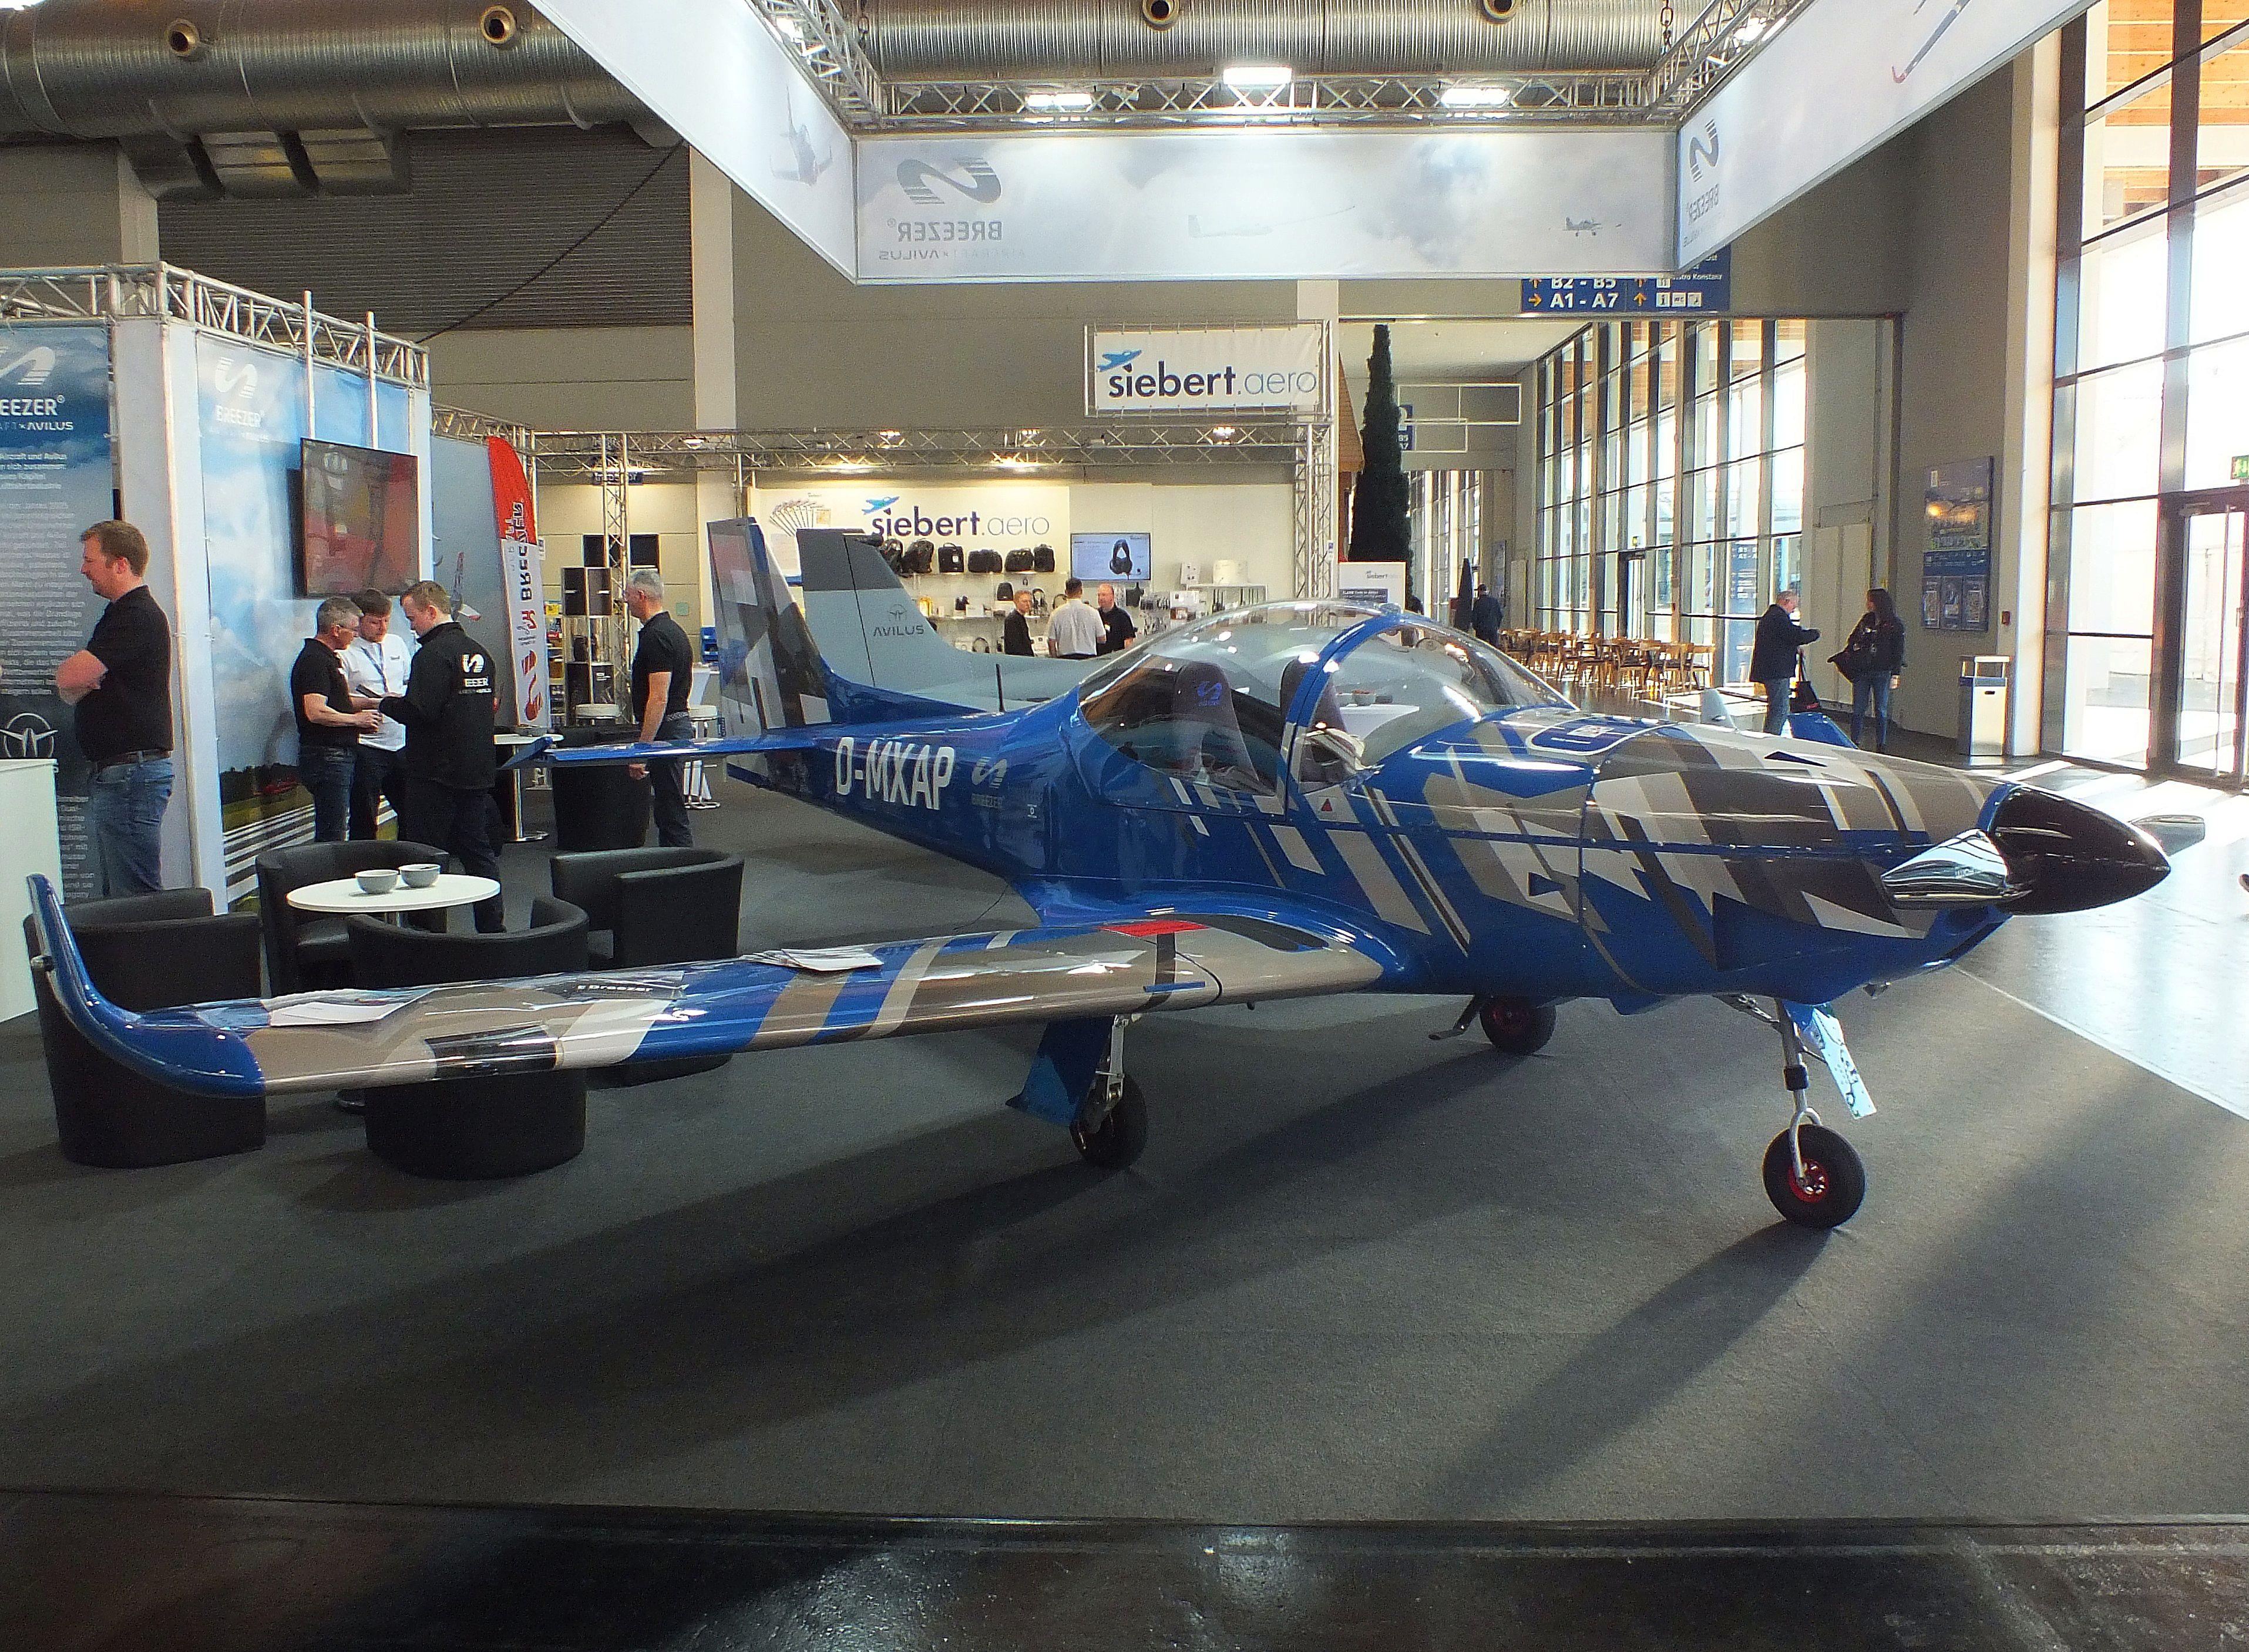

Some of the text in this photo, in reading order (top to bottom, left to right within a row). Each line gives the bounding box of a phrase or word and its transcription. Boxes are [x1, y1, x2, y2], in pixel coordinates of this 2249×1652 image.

[1550, 294, 1574, 308] A1
[1592, 294, 1618, 308] A7
[1108, 359, 1317, 398] siebert.aero
[27, 422, 74, 430] AVILUS
[872, 506, 1050, 537] siebert.aero
[873, 625, 925, 637] AVILUS
[836, 736, 955, 811] D-MXAP
